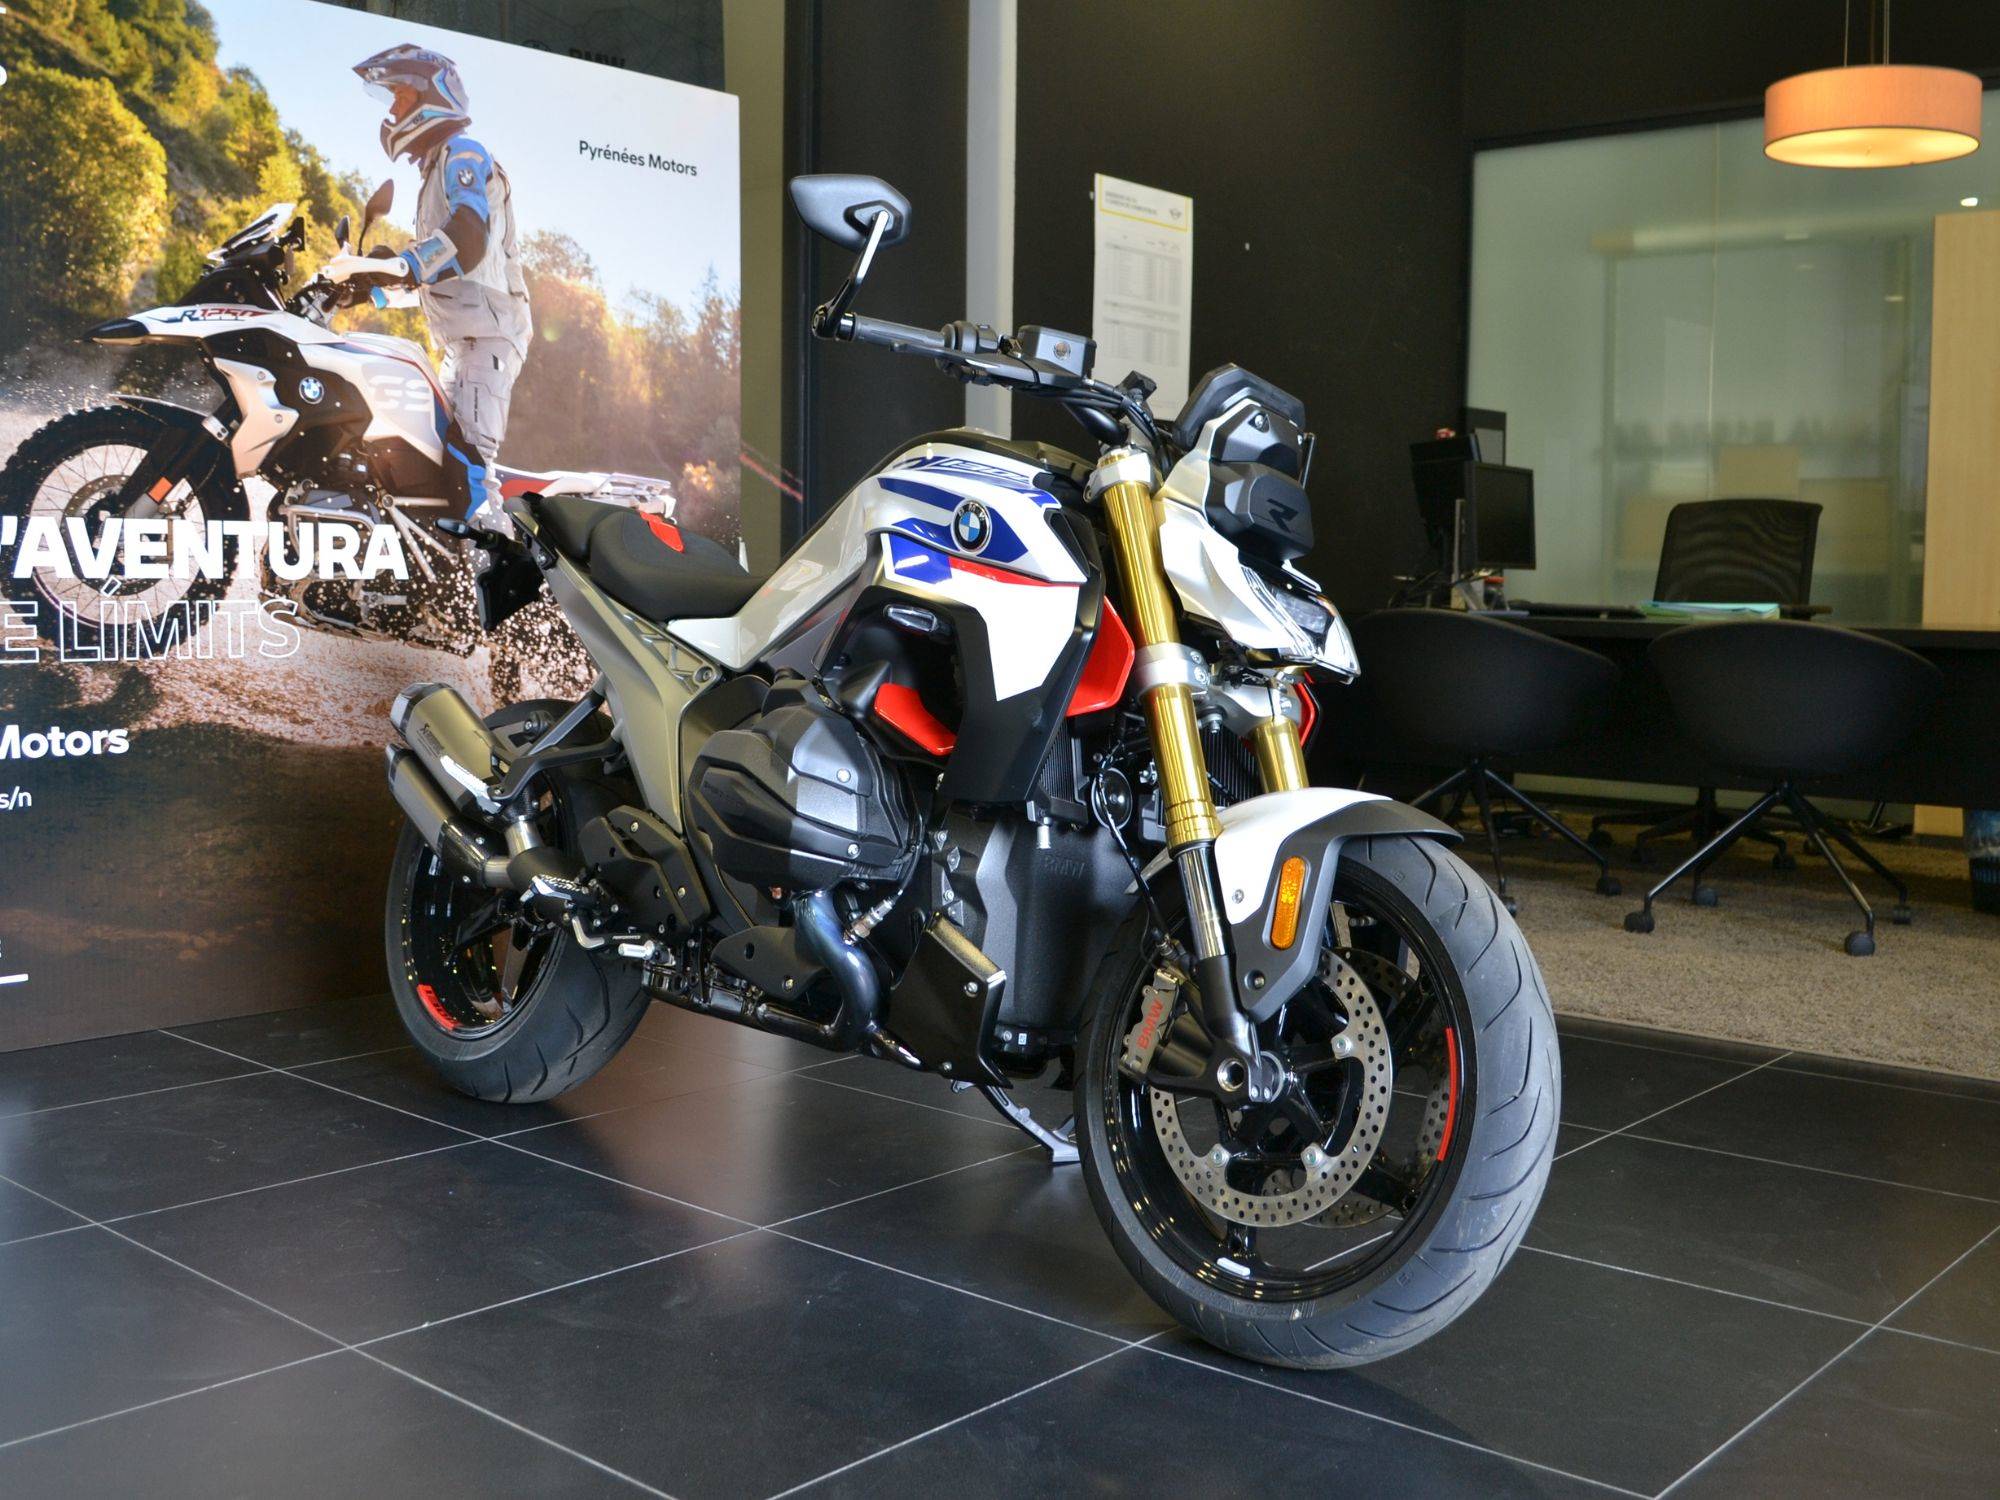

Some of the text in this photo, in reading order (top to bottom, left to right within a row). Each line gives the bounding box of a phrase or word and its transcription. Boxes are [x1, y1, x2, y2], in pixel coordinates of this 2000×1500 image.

[579, 140, 698, 177] Pyrénées Motors
[60, 576, 301, 663] LÍMITS
[0, 785, 32, 810] s/n
[1136, 998, 1164, 1049] BMW
